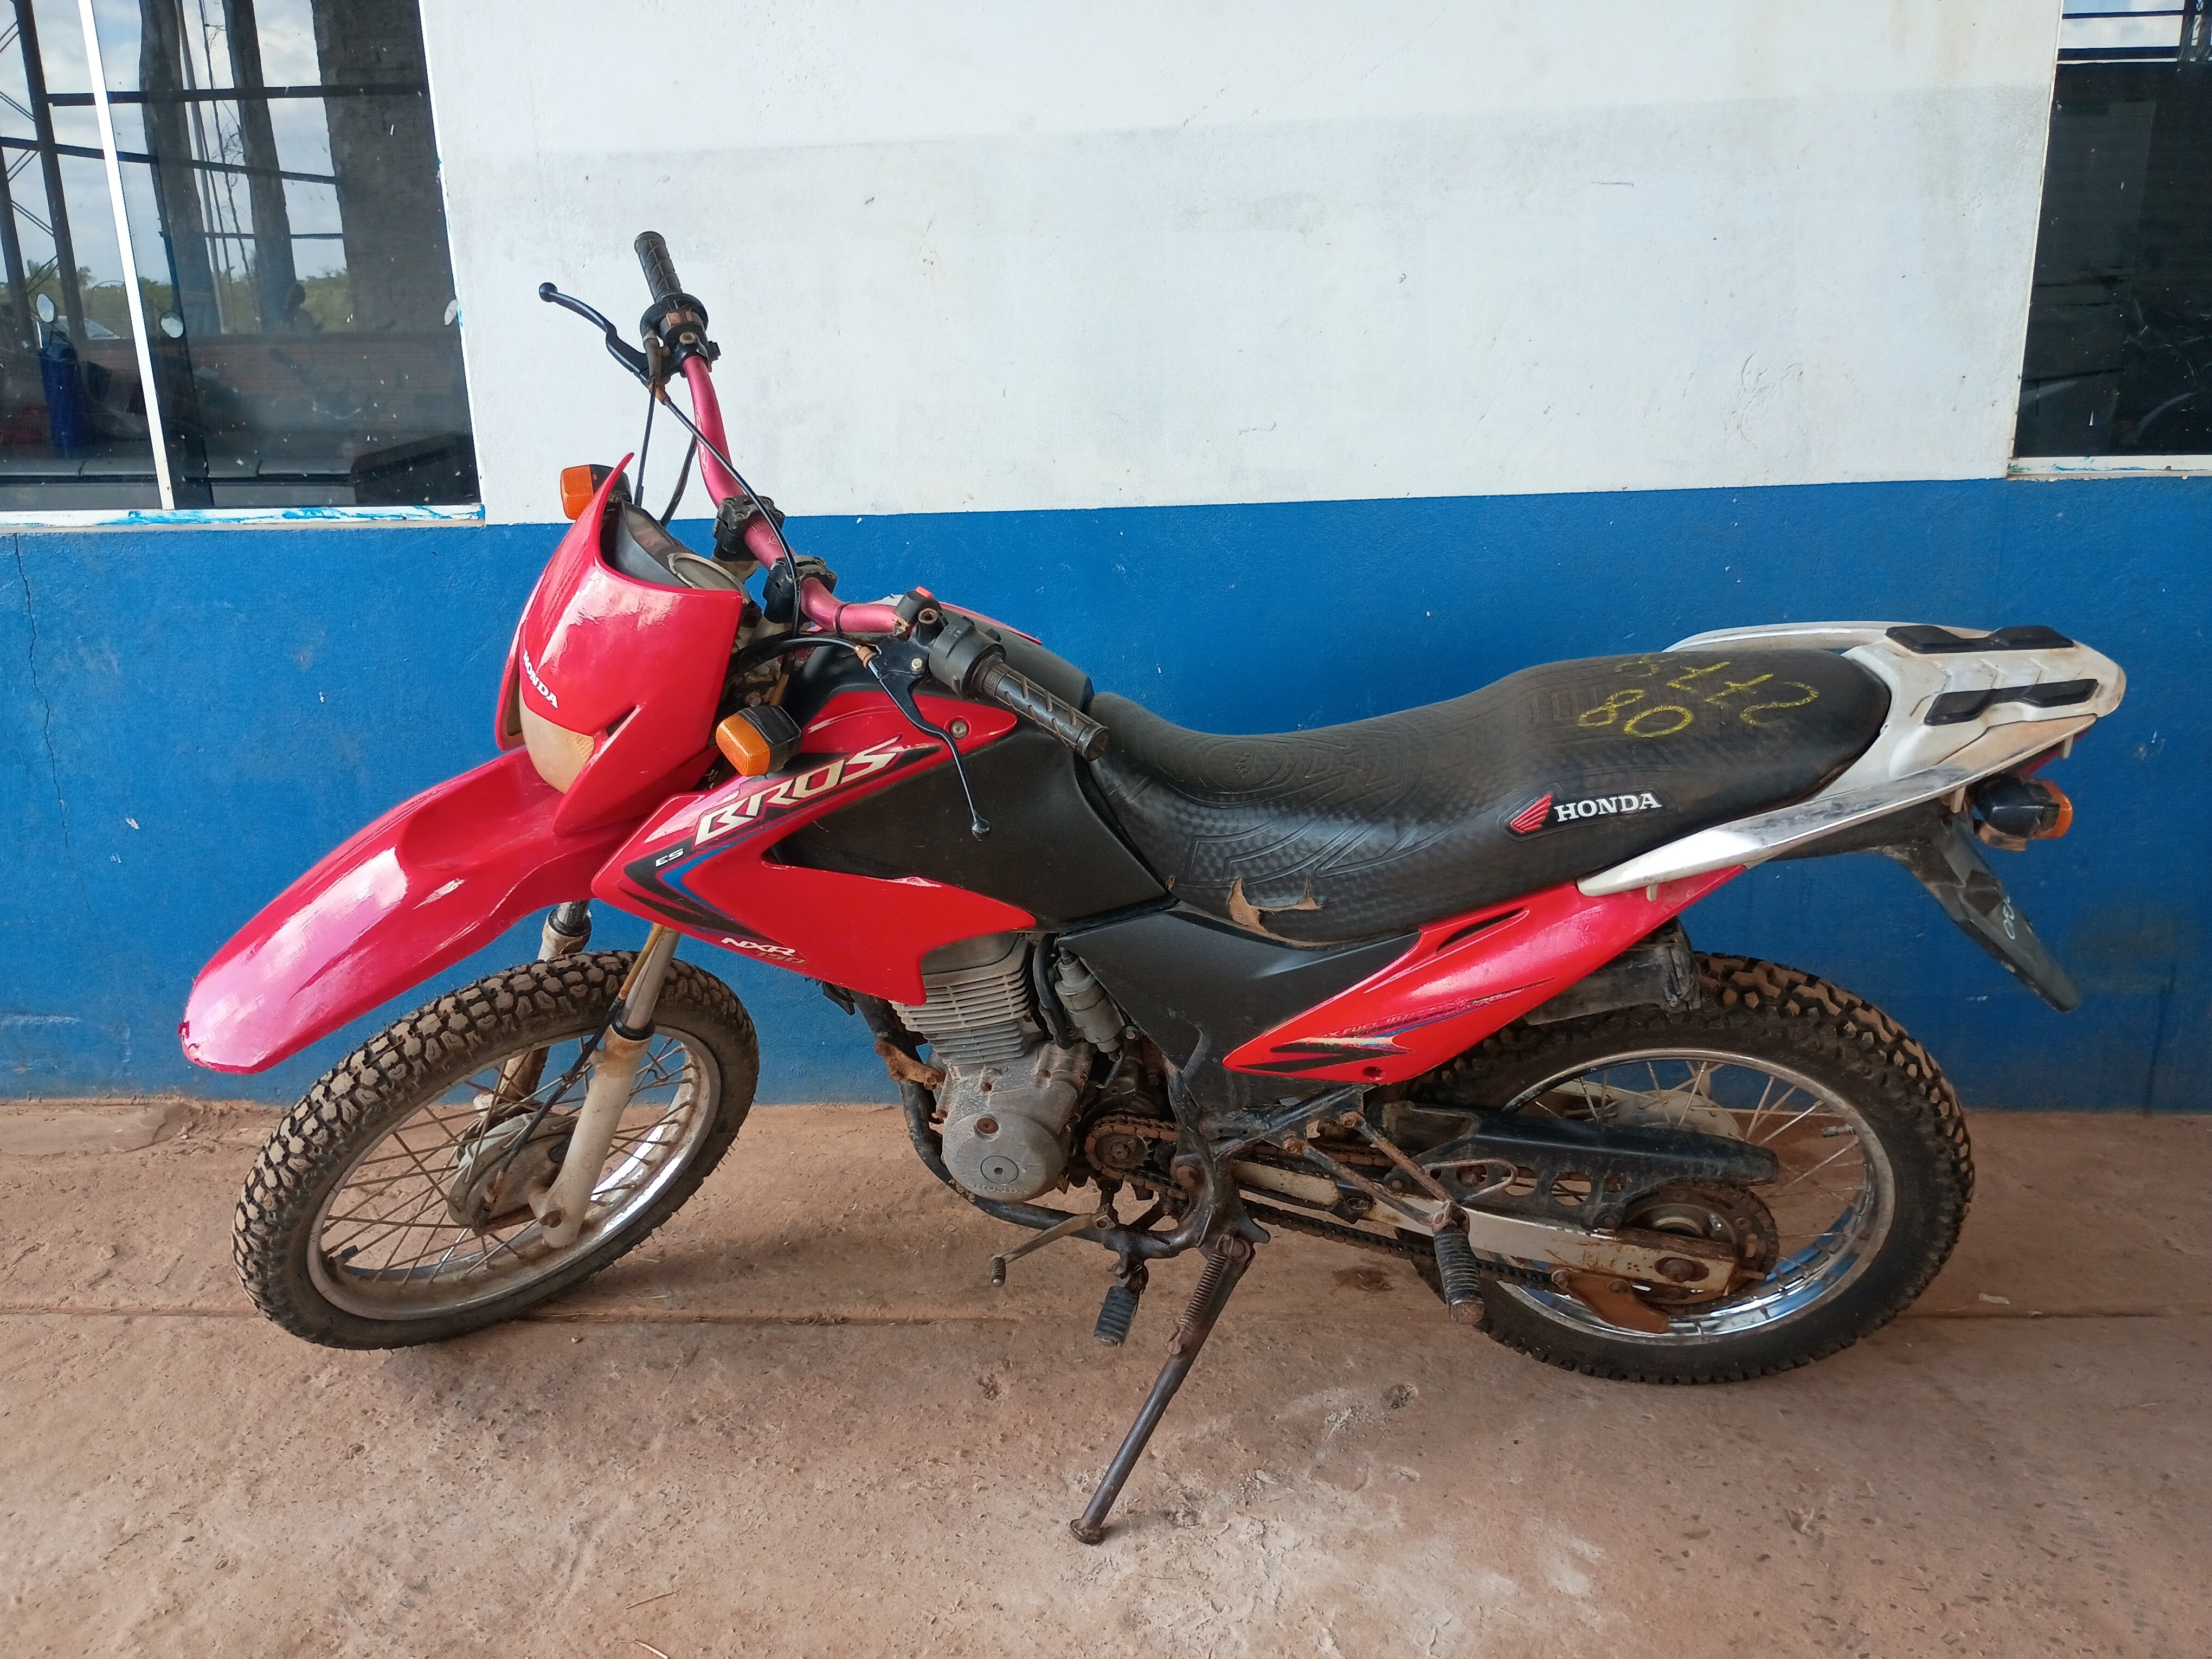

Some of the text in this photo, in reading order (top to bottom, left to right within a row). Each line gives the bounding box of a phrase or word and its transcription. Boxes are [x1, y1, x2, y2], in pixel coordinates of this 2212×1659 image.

[523, 651, 558, 709] HONDA
[695, 736, 901, 847] BROS
[1553, 793, 1663, 822] HONDA
[655, 848, 684, 867] ES
[721, 937, 795, 956] NXR
